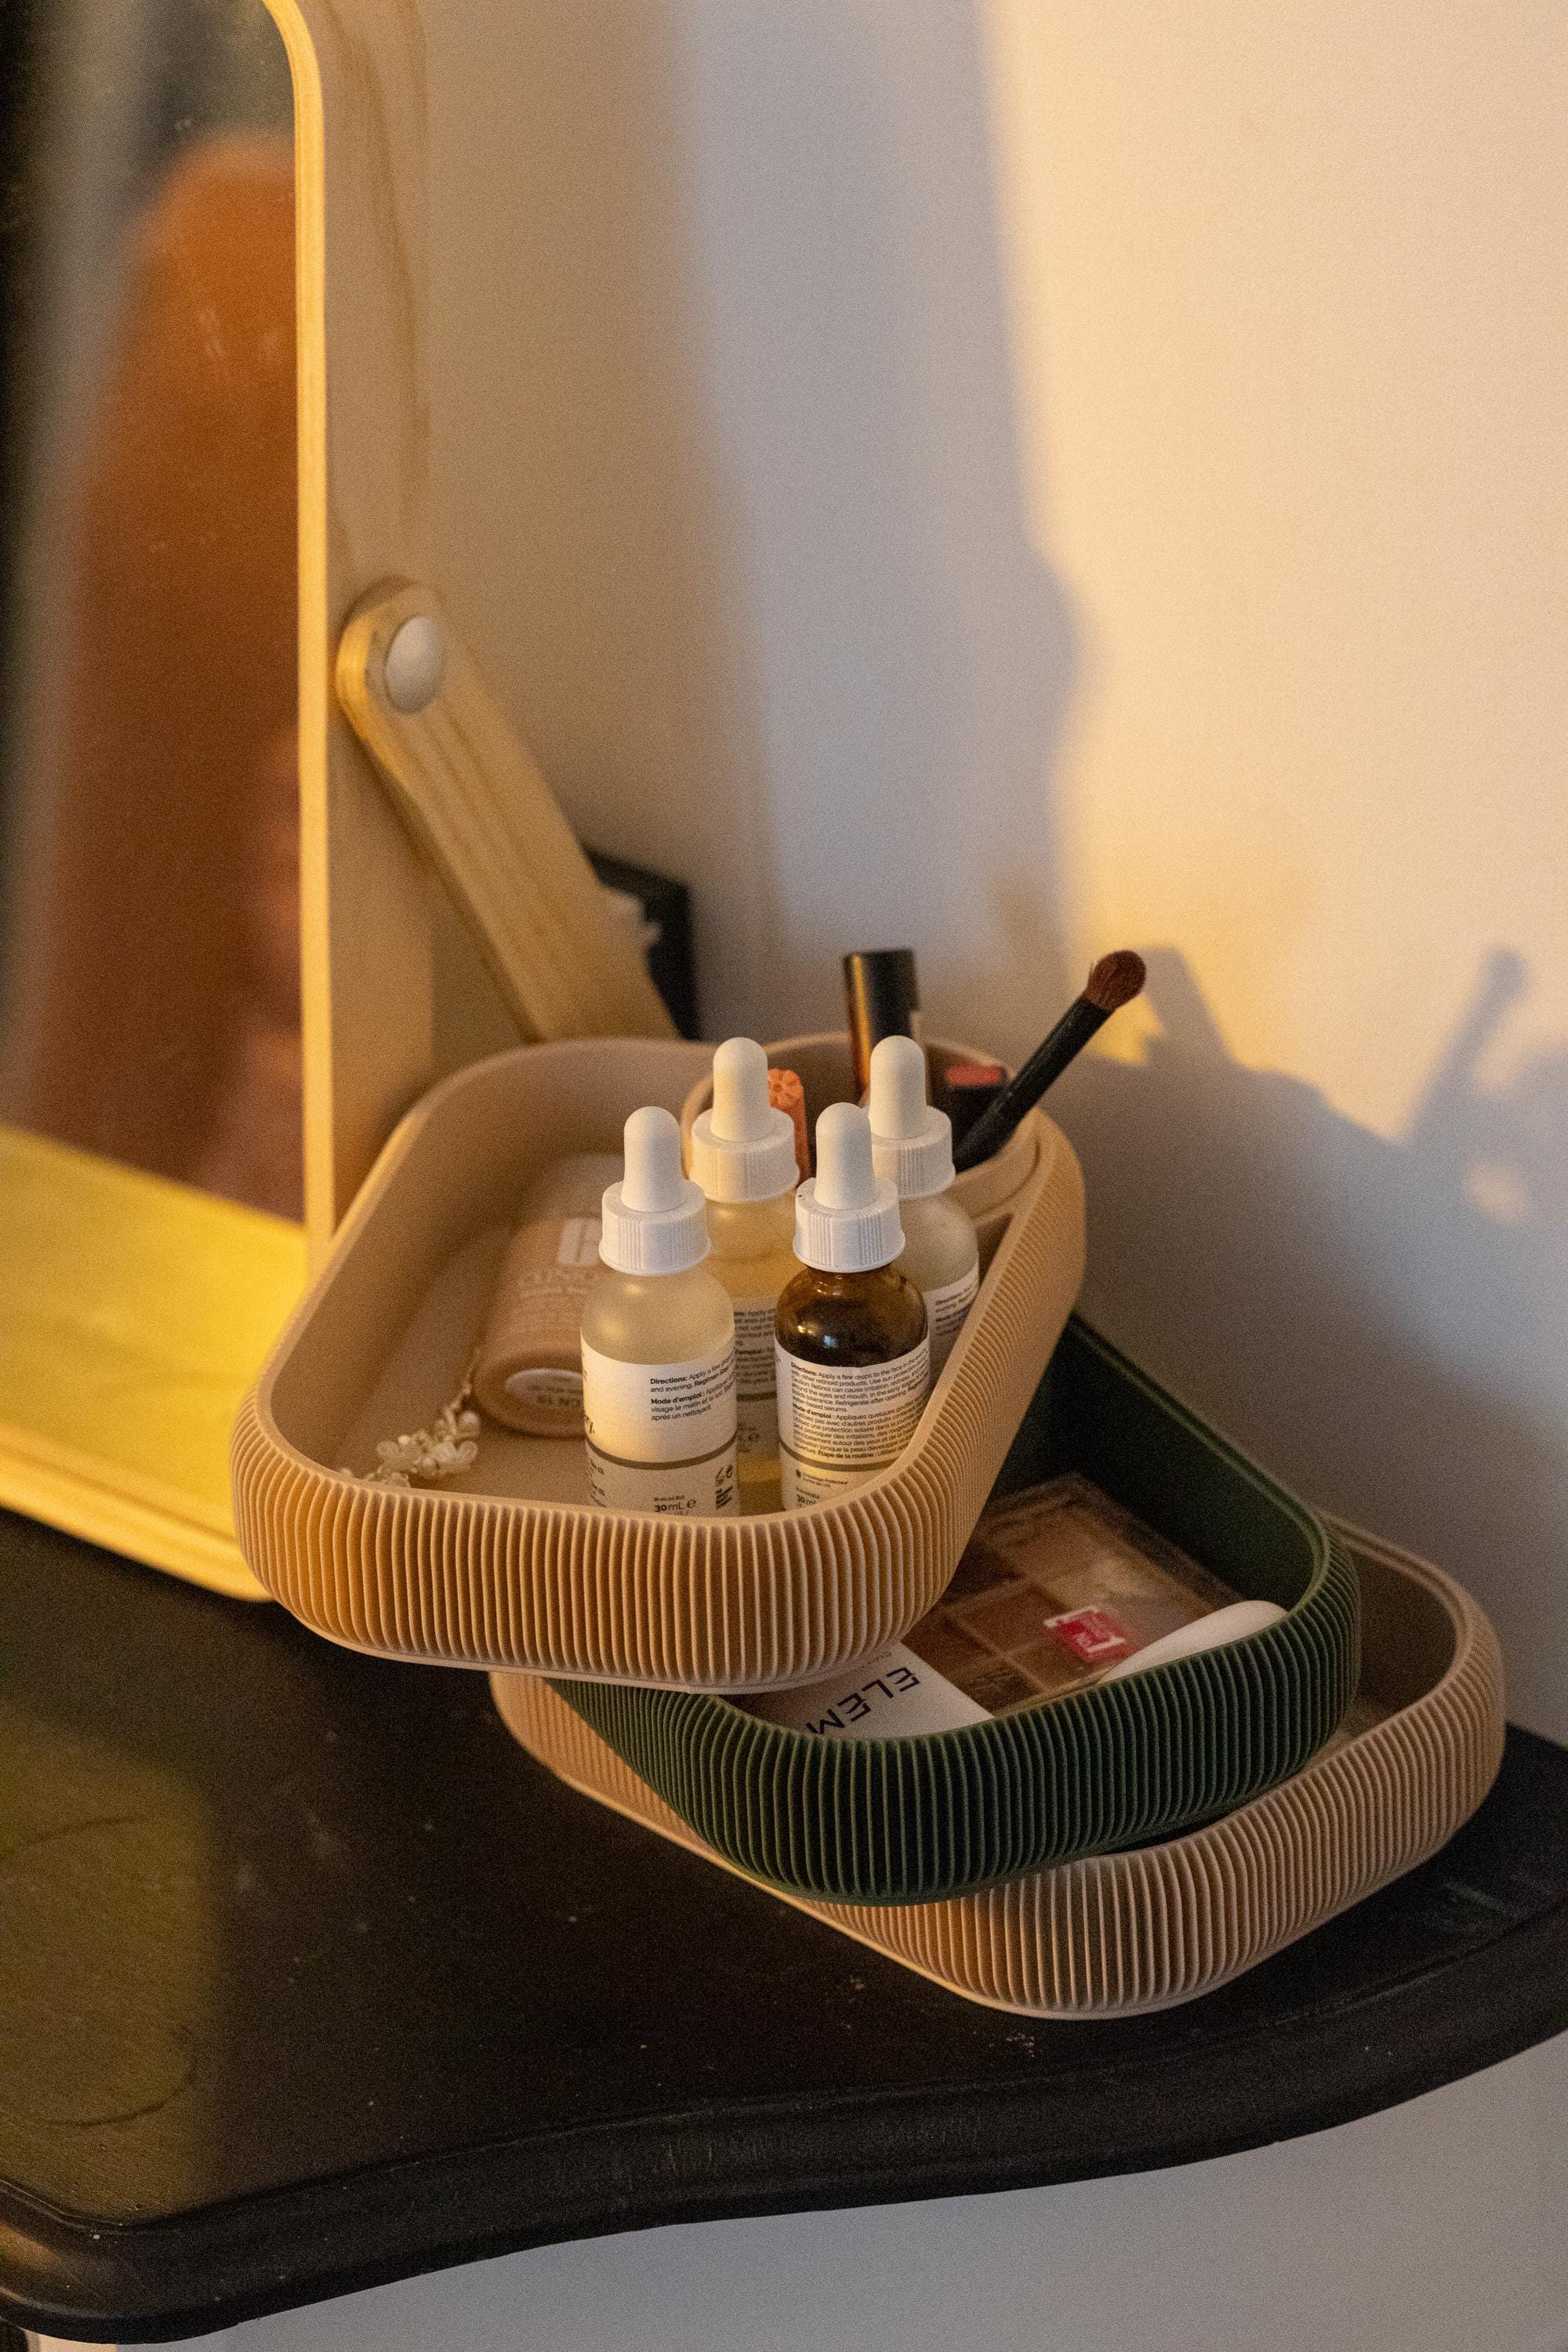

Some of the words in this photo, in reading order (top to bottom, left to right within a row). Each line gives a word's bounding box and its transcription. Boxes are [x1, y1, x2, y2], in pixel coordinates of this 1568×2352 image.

[791, 1362, 817, 1376] Directions:
[650, 1376, 688, 1385] Directions:
[688, 1371, 706, 1380] Apply
[811, 1383, 830, 1392] Retinol
[673, 1392, 702, 1403] d'emploi
[683, 1400, 701, 1409] matin
[807, 1410, 831, 1418] d'emploi
[867, 1417, 891, 1426] produits
[804, 1428, 832, 1438] provoquer
[655, 1504, 667, 1512] 30
[668, 1501, 684, 1511] mL
